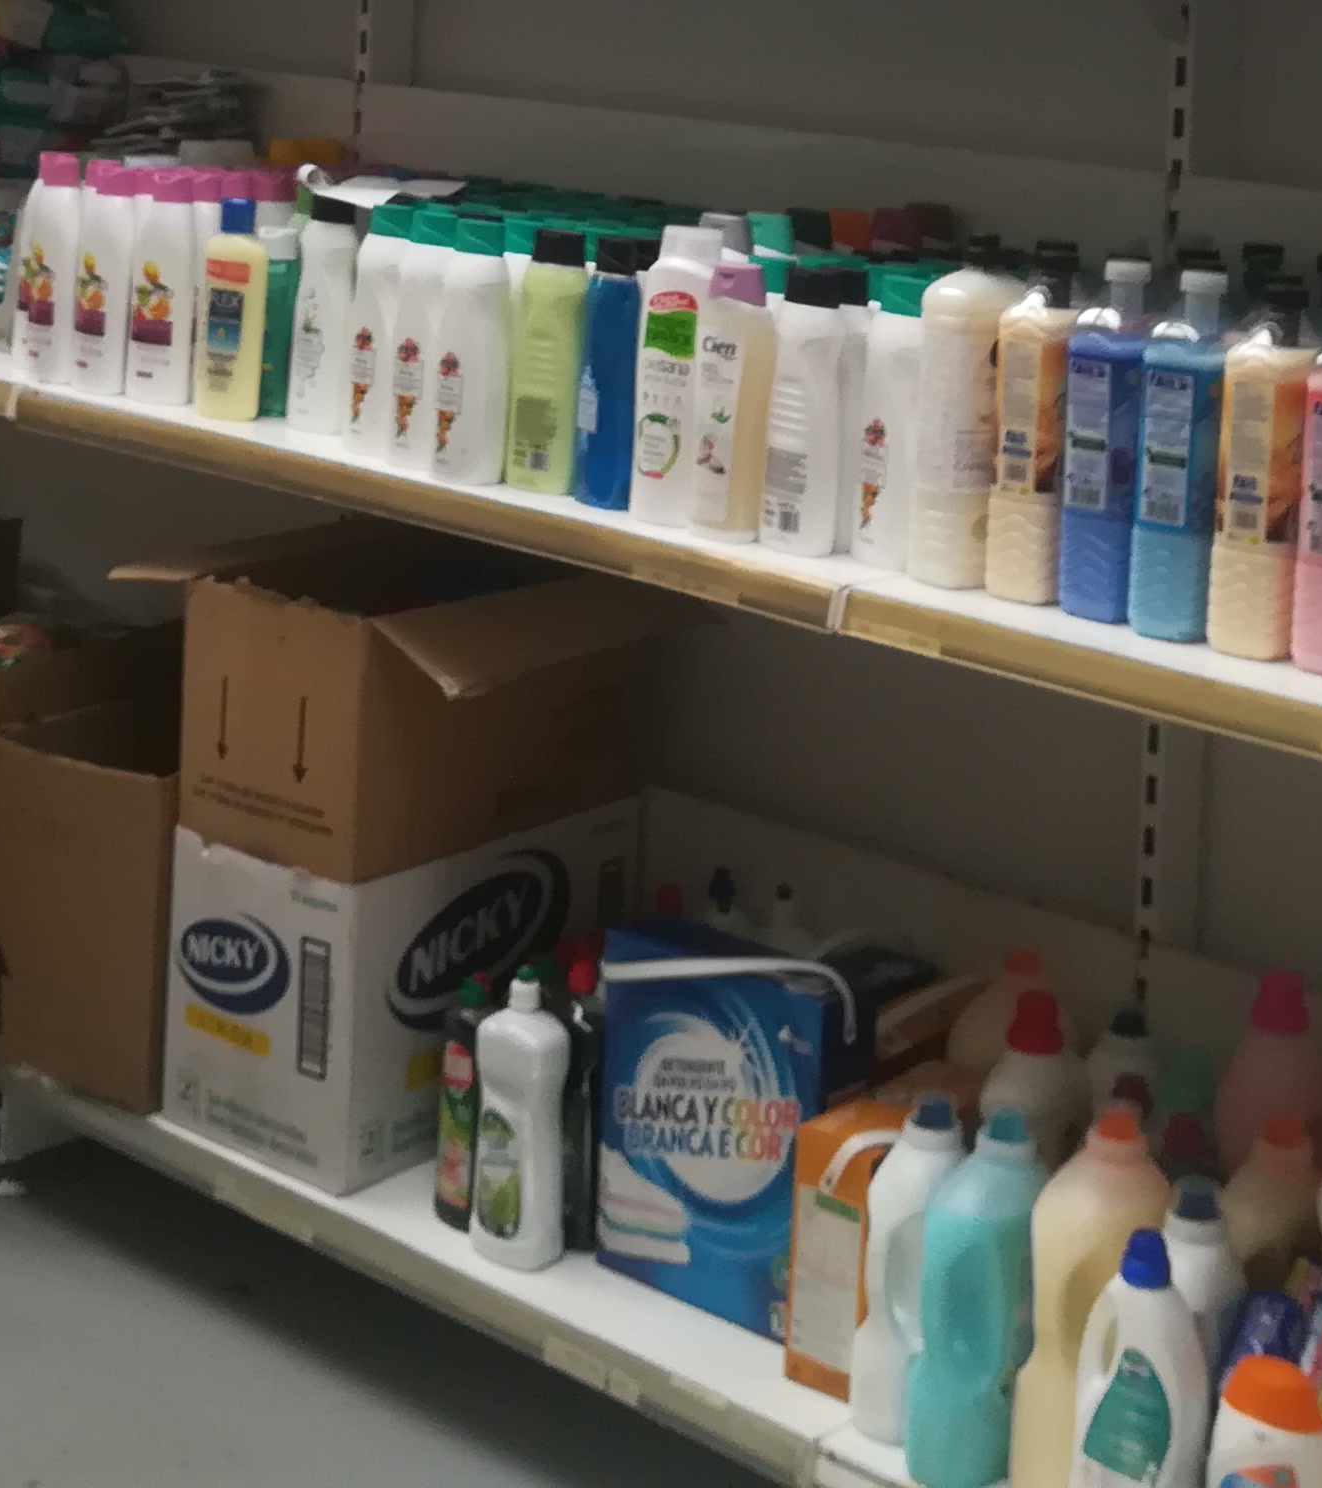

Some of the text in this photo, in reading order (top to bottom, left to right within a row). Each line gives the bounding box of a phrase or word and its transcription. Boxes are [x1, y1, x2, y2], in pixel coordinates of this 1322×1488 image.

[701, 335, 738, 358] Cien
[187, 930, 262, 972] NICKY
[408, 879, 533, 994] NICKY
[613, 1086, 800, 1132] BLANCA Y COLOR
[624, 1123, 782, 1162] BRANCA E COR
